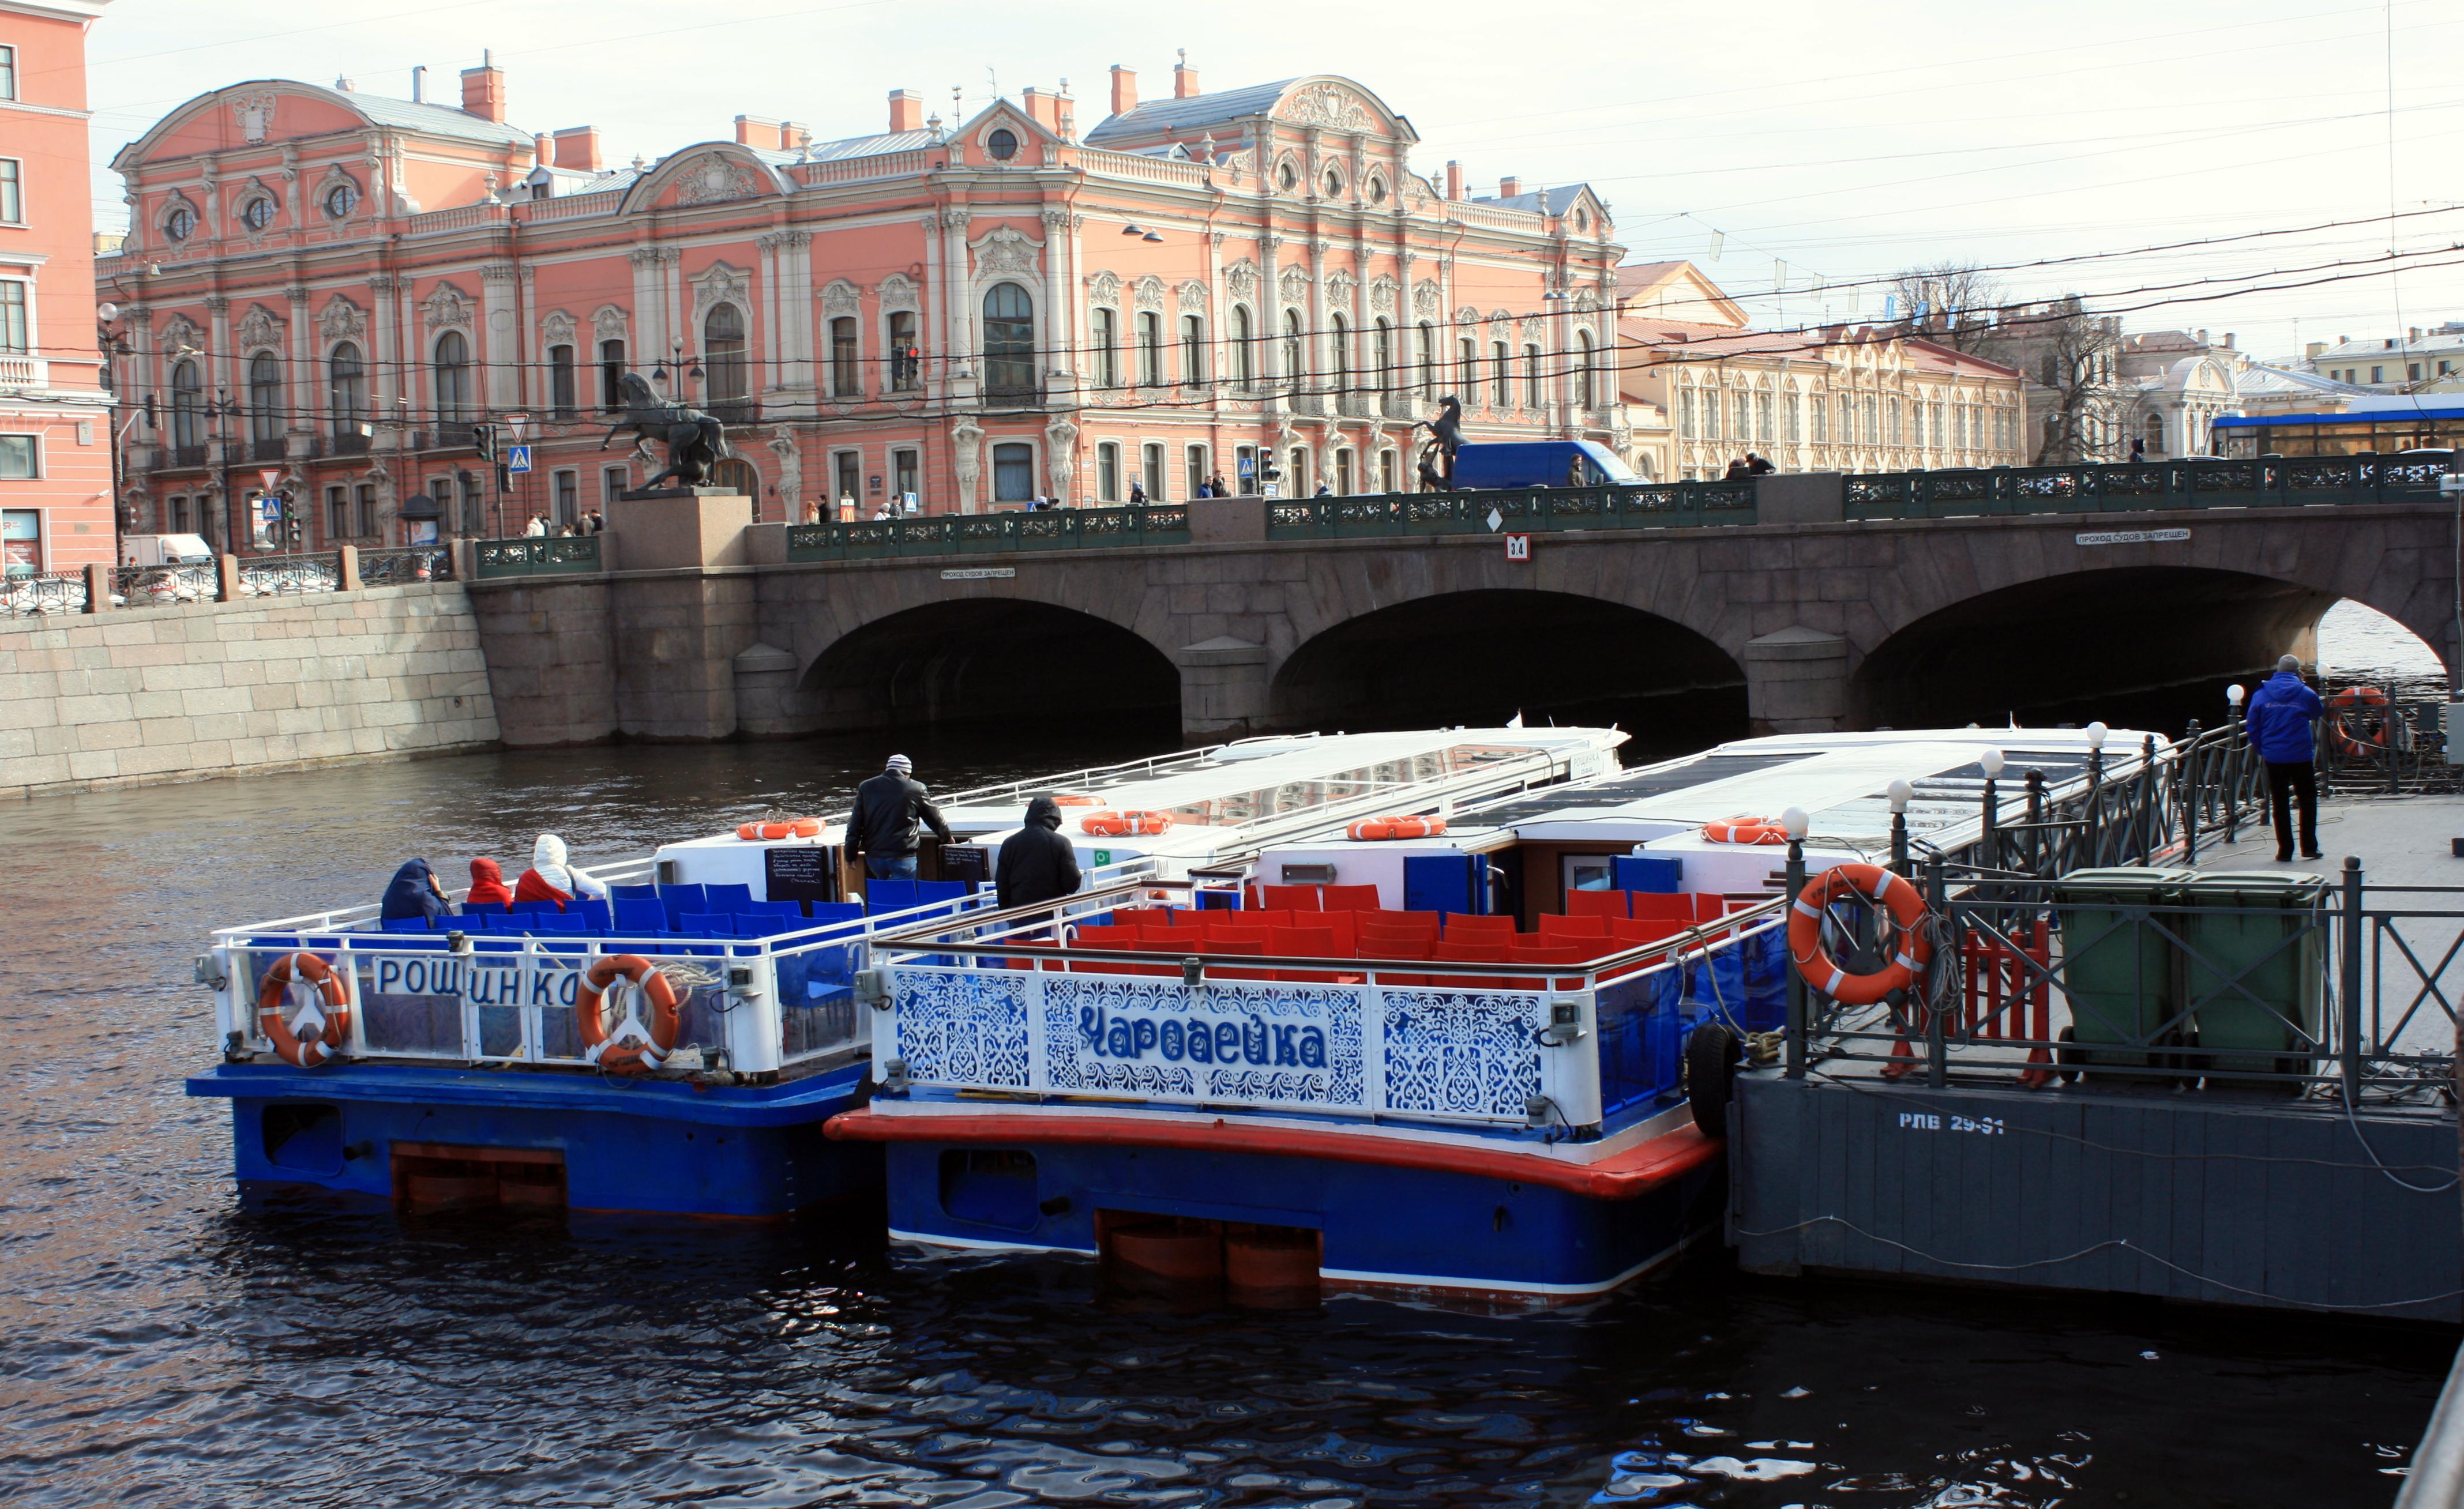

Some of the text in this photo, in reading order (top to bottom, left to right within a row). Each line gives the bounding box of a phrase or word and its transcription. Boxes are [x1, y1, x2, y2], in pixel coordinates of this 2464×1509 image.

[2143, 531, 2188, 540] ЗАПРЕЩЕН
[1511, 543, 1523, 555] 3.4
[1899, 1113, 1941, 1130] РЛВ
